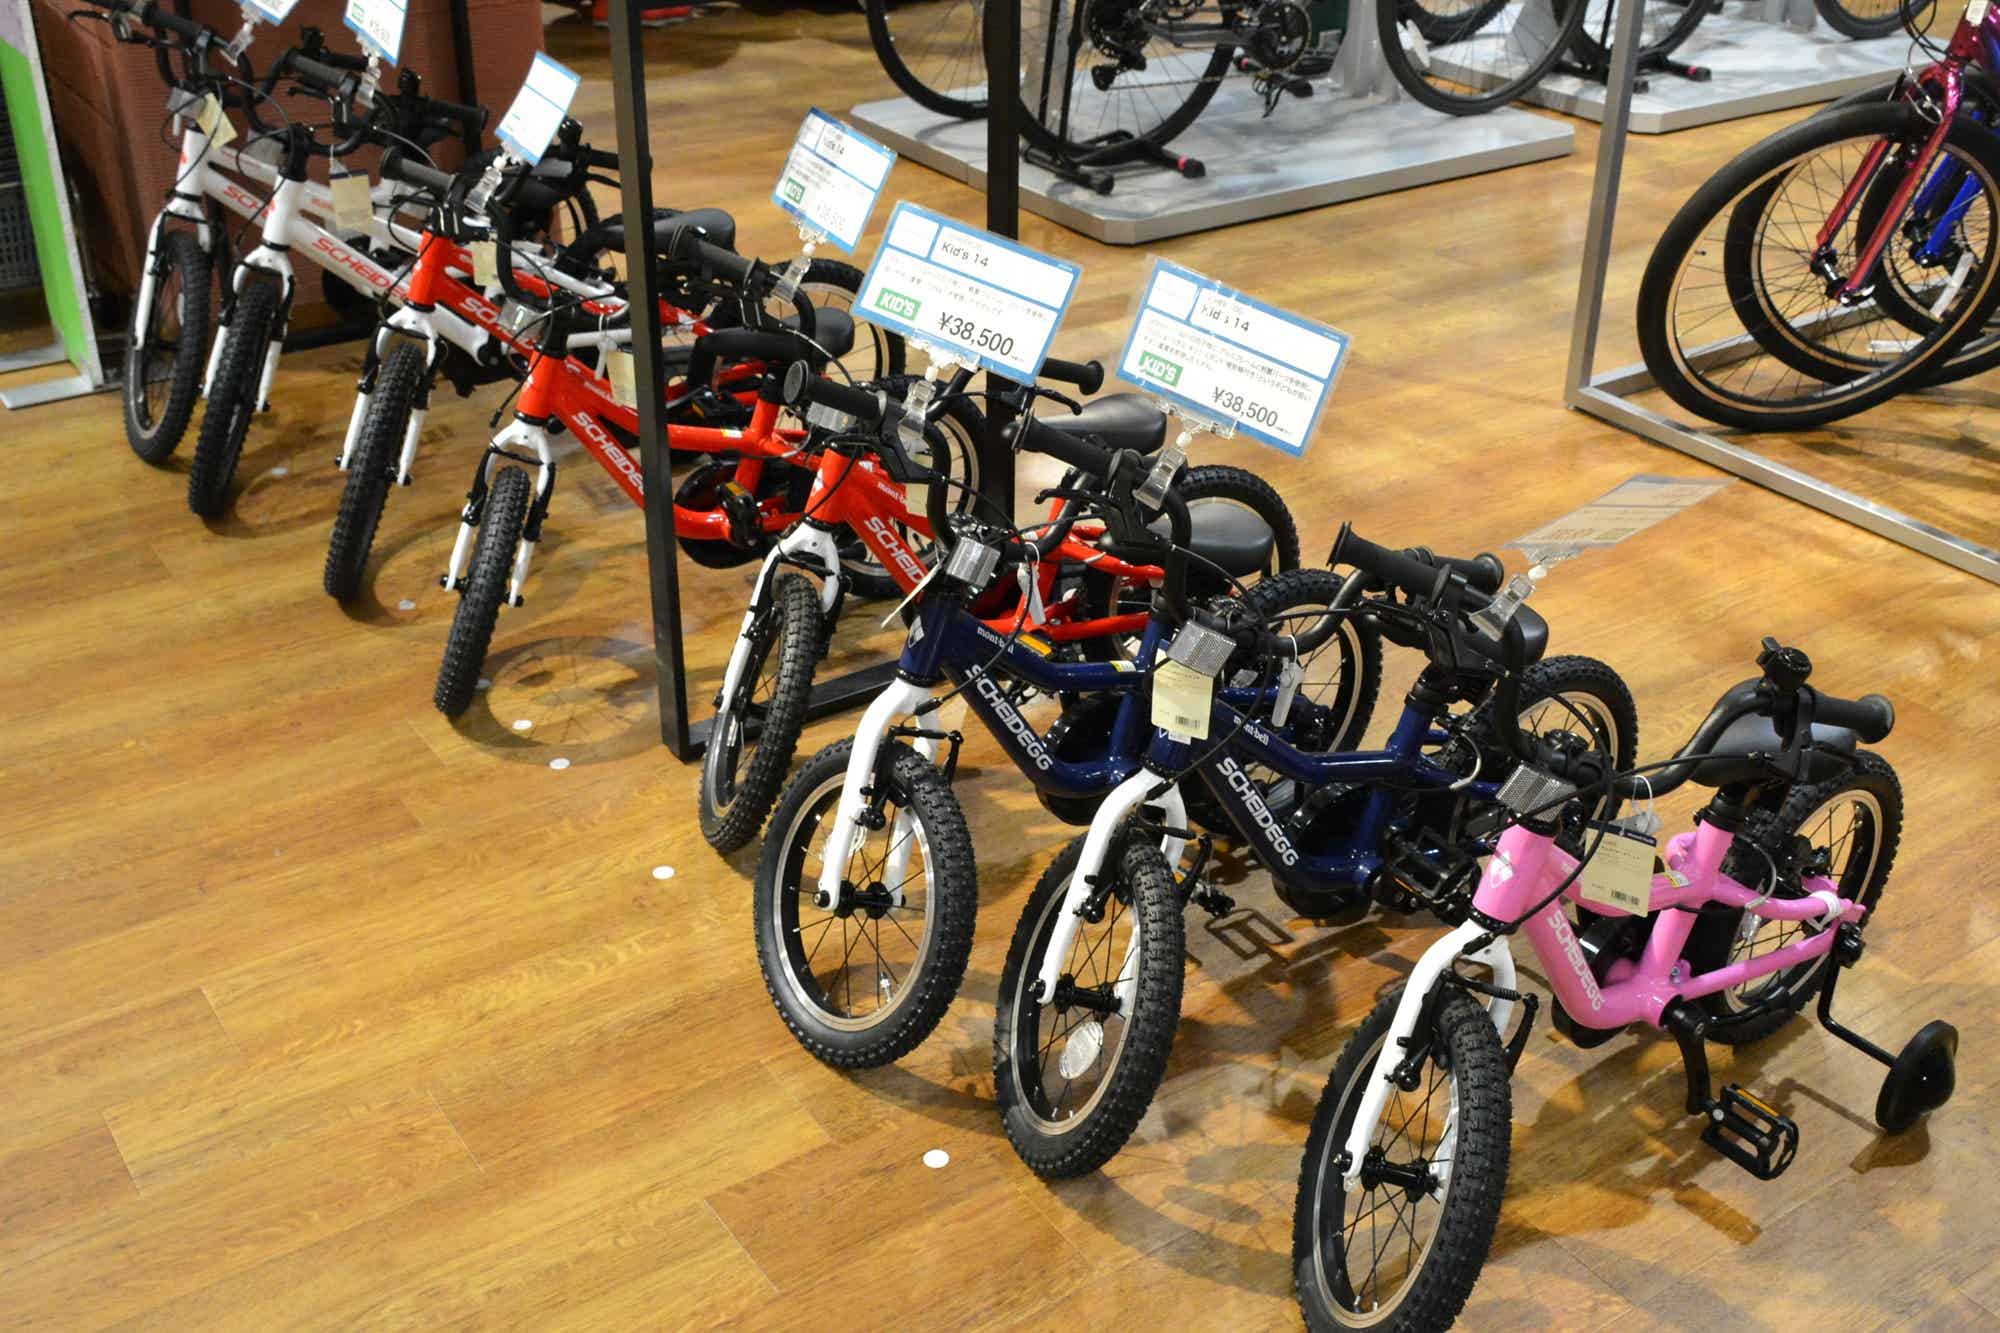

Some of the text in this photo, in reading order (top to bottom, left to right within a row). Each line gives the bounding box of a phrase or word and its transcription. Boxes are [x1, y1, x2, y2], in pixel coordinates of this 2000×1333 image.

[941, 241, 989, 268] Kid's 14
[879, 291, 916, 318] KID'S
[937, 311, 1015, 357] ¥38,500
[1233, 317, 1251, 333] 14
[1141, 355, 1178, 382] KID'S
[1212, 386, 1279, 428] ¥38,500
[863, 516, 928, 585] SCHEID
[977, 626, 1015, 655] mont-bll
[964, 664, 1054, 771] SCHEIDEGG
[1233, 714, 1270, 747] mnt-bell
[1215, 756, 1300, 867] SCHEIDEGG
[1546, 909, 1606, 1012] SCHEIDEGG
